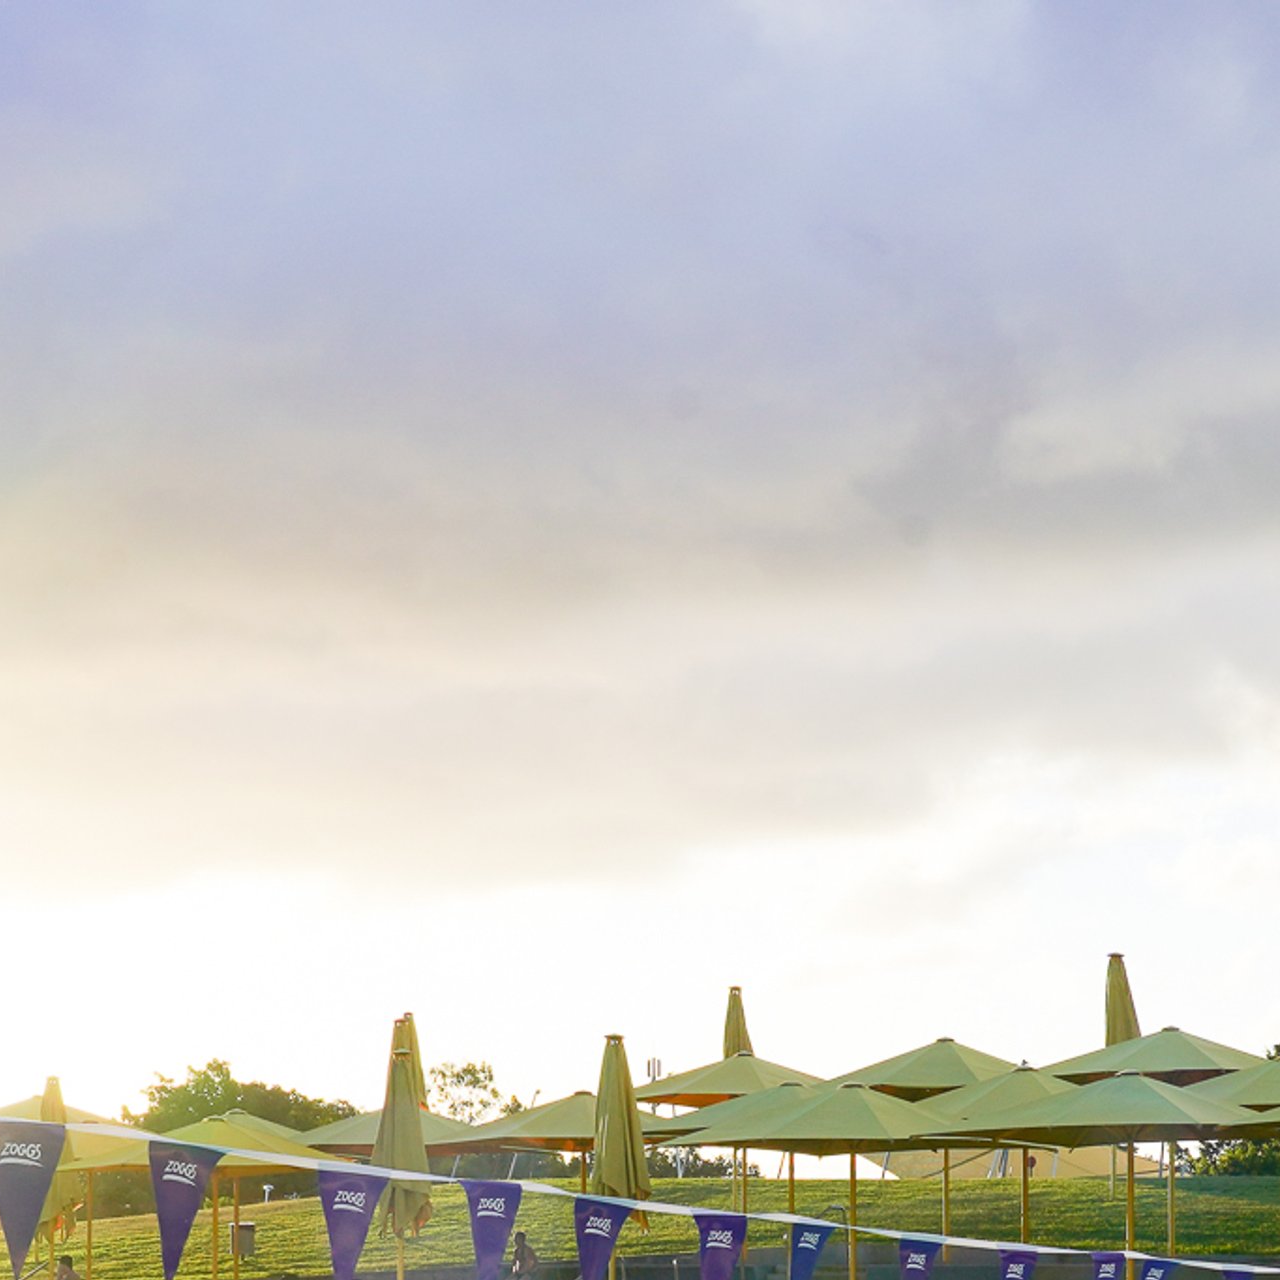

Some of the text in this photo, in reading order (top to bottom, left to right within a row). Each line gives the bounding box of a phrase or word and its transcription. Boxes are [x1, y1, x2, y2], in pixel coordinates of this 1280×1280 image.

[0, 1142, 42, 1160] ZOGGS
[164, 1160, 197, 1179] ZOGGS
[334, 1190, 366, 1206] ZOGGS
